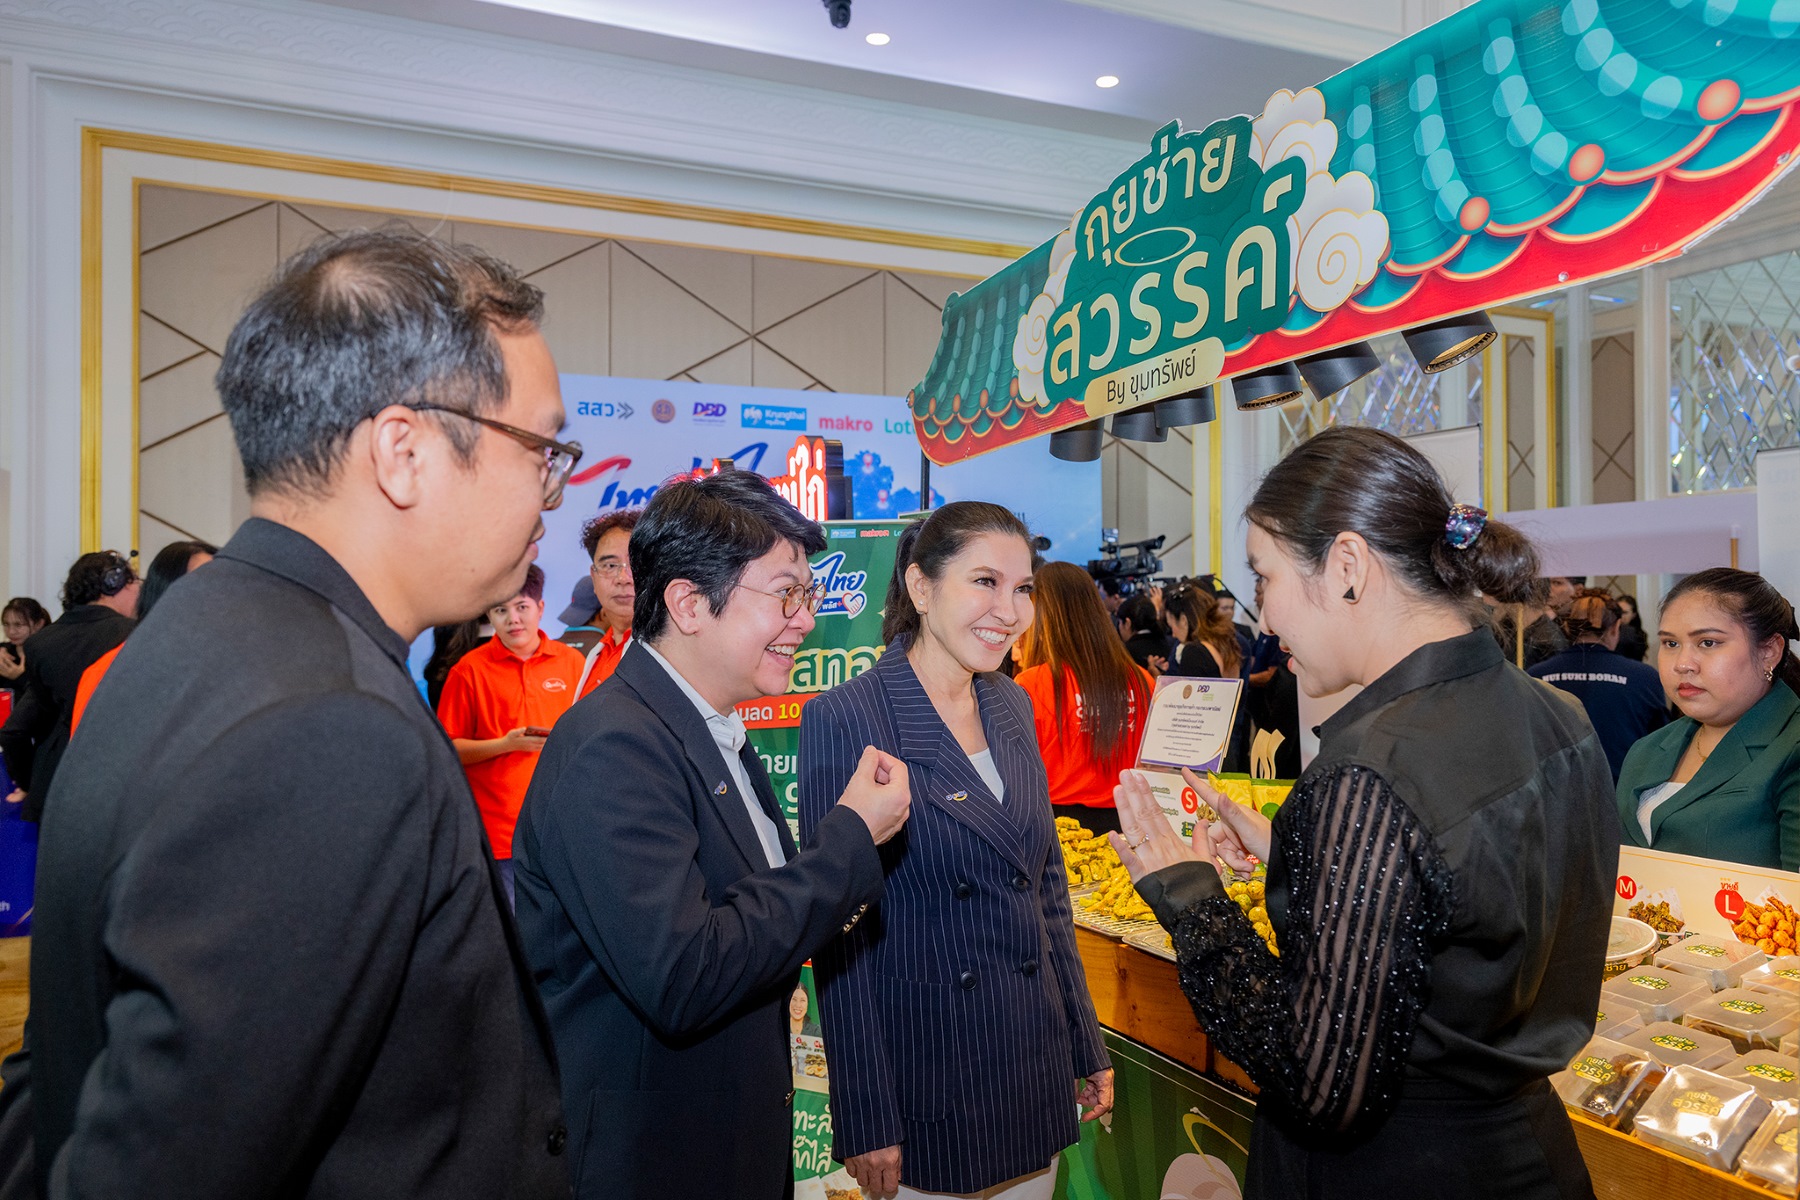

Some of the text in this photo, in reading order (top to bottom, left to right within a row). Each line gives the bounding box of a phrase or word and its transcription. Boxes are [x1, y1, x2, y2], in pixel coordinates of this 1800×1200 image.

[1084, 134, 1238, 267] กุยช่าย
[1050, 174, 1293, 385] สวรรค์
[1107, 380, 1125, 405] By
[693, 402, 727, 417] DBD
[819, 416, 874, 432] makro
[1561, 673, 1587, 681] SUKI
[1588, 673, 1627, 685] BORAN
[1185, 791, 1194, 809] S
[1619, 879, 1633, 896] M
[1725, 894, 1737, 915] L
